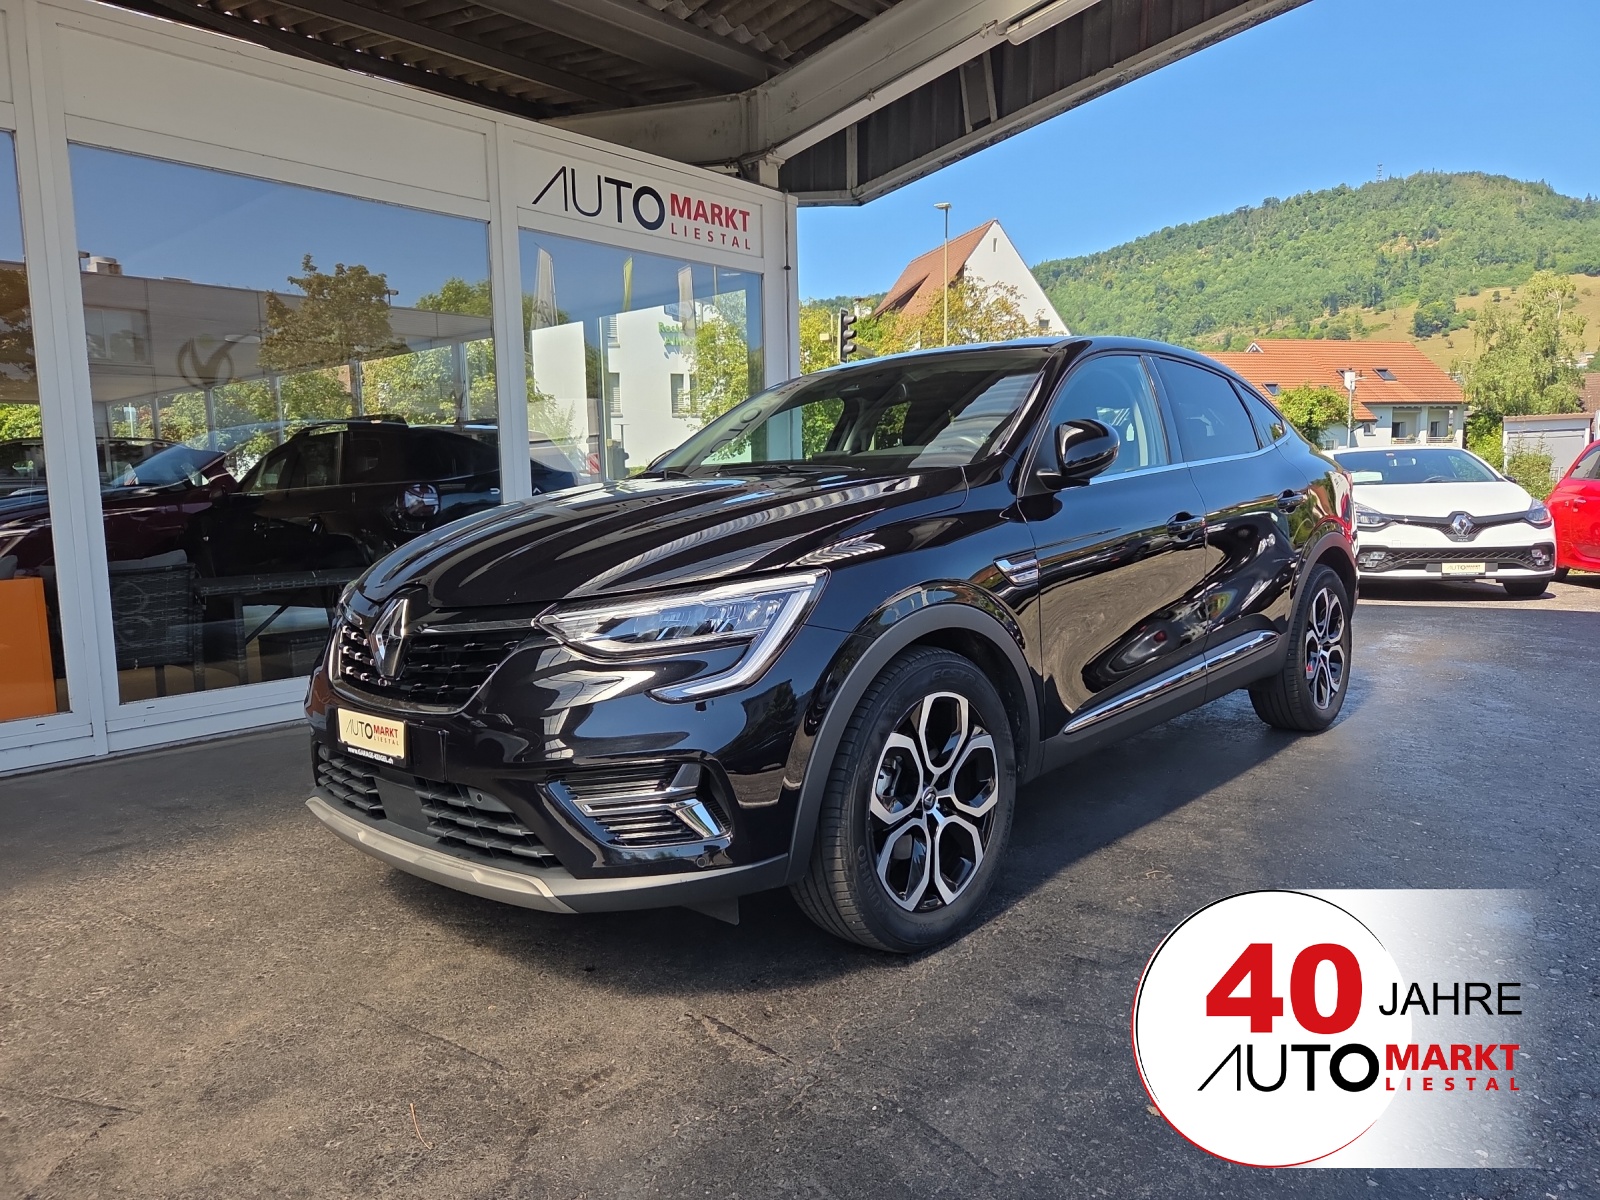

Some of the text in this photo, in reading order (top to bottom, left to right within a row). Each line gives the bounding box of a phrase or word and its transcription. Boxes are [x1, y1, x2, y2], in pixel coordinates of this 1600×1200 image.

[531, 165, 750, 232] AUTO MARKT
[671, 222, 751, 250] LIESTAL
[345, 718, 399, 740] AUTO MARKT
[373, 736, 400, 746] LIESTAL
